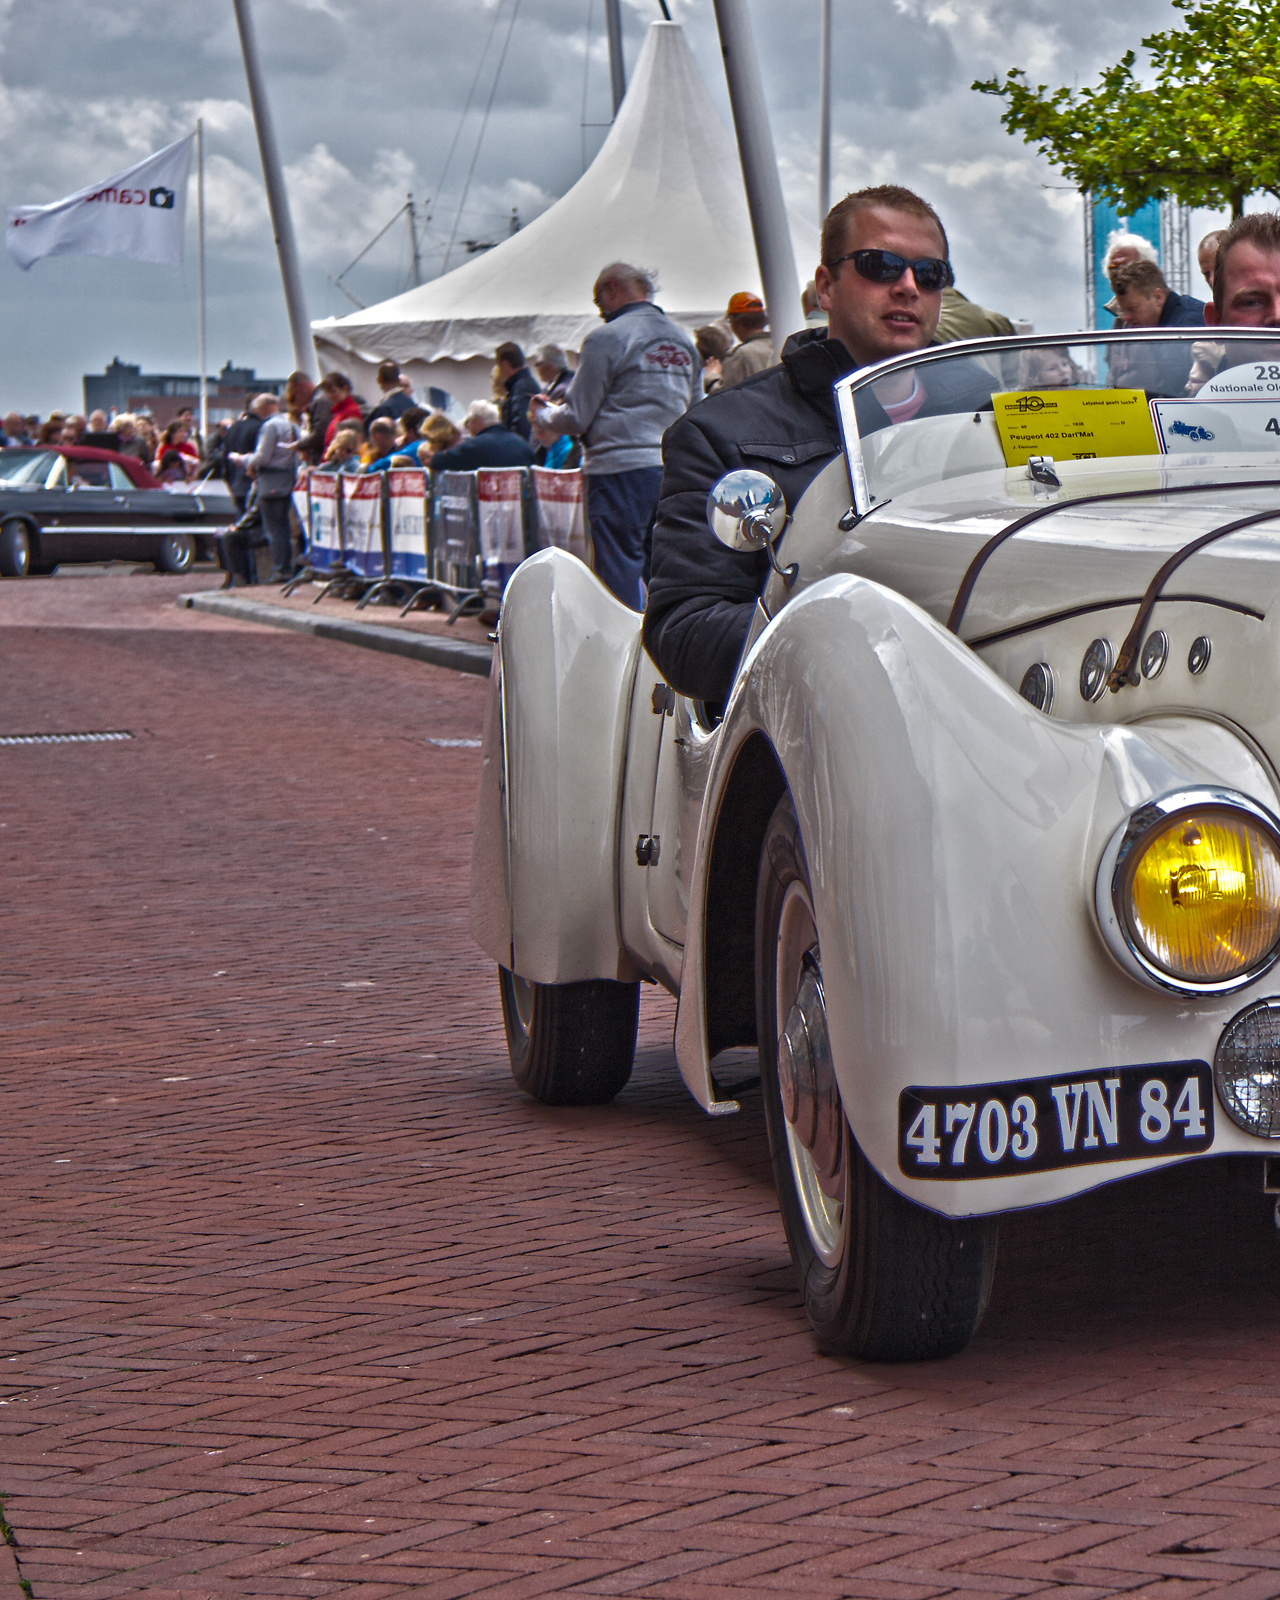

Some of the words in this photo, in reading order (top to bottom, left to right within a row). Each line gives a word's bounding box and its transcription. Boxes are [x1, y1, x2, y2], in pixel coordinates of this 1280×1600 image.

[1210, 383, 1264, 393] Nationale
[1010, 433, 1043, 441] Peugeot
[905, 1095, 1038, 1165] 4703
[1051, 1078, 1121, 1151] VN
[1139, 1076, 1206, 1143] 84
